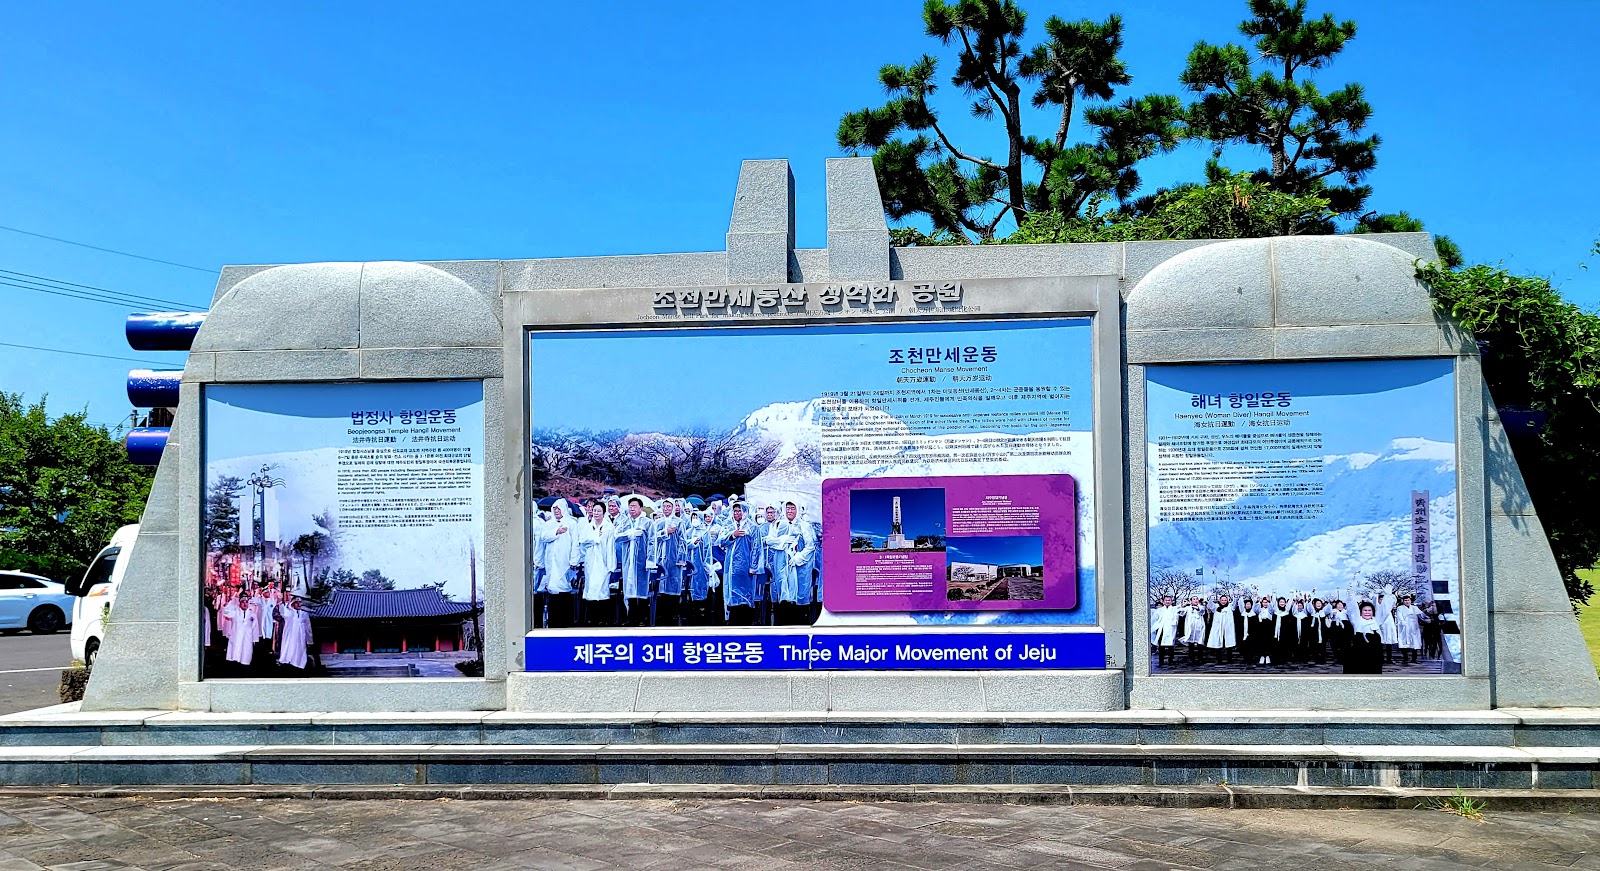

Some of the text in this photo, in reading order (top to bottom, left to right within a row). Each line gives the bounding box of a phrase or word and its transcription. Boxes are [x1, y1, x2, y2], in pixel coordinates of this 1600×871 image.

[653, 281, 963, 309] 조천만세동산 성역화 공원
[888, 346, 998, 365] 조천만세운동
[1191, 392, 1292, 409] 해녀 항일운동
[351, 409, 457, 425] 법정사 항일운동
[1232, 411, 1252, 419] Diver)
[573, 641, 1057, 665] 제주의 3대 항일운동 Three Major Movement of Jeju
